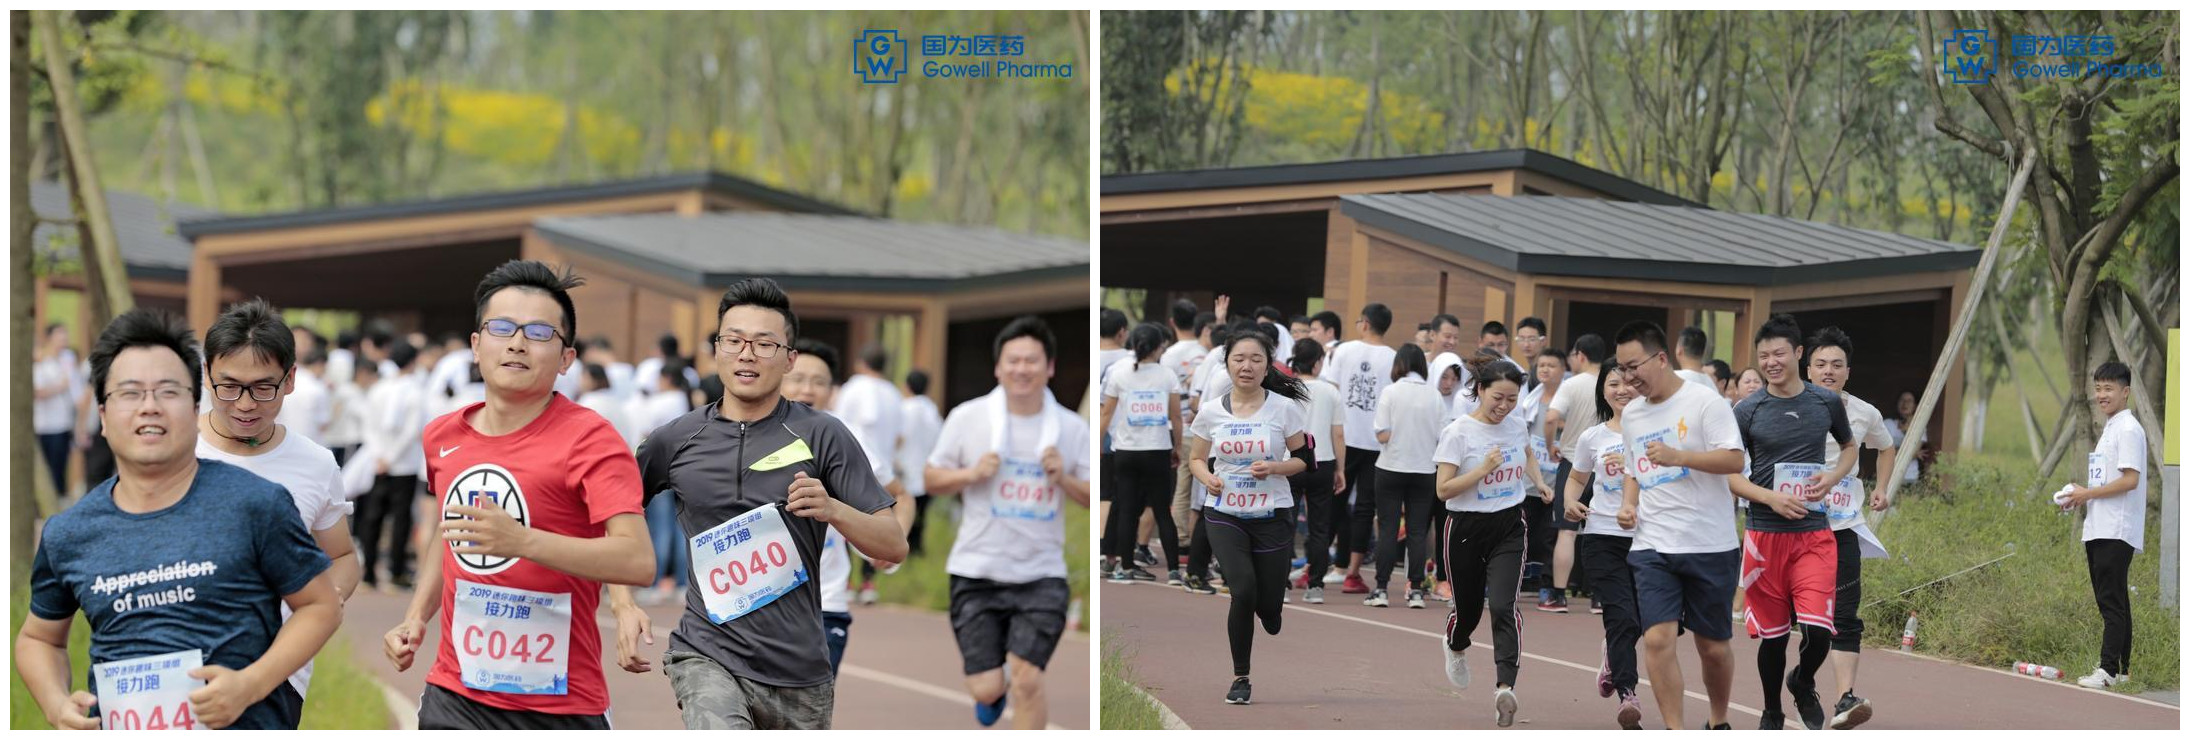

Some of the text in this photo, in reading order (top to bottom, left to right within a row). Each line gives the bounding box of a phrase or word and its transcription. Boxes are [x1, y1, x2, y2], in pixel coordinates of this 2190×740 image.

[1220, 441, 1265, 455] C071
[1484, 465, 1523, 485] C070
[1000, 481, 1055, 505] C041
[1226, 492, 1268, 508] C077
[1833, 492, 1851, 507] 067
[695, 532, 713, 548] 2019
[713, 527, 752, 555] 接力跑
[90, 560, 217, 595] Appreciation
[709, 541, 787, 595] C040
[113, 585, 196, 613] of music
[469, 587, 492, 598] 2019
[484, 601, 531, 620] 接力跑
[463, 624, 555, 663] C042
[117, 674, 160, 695] 接力跑
[109, 701, 196, 730] C044
